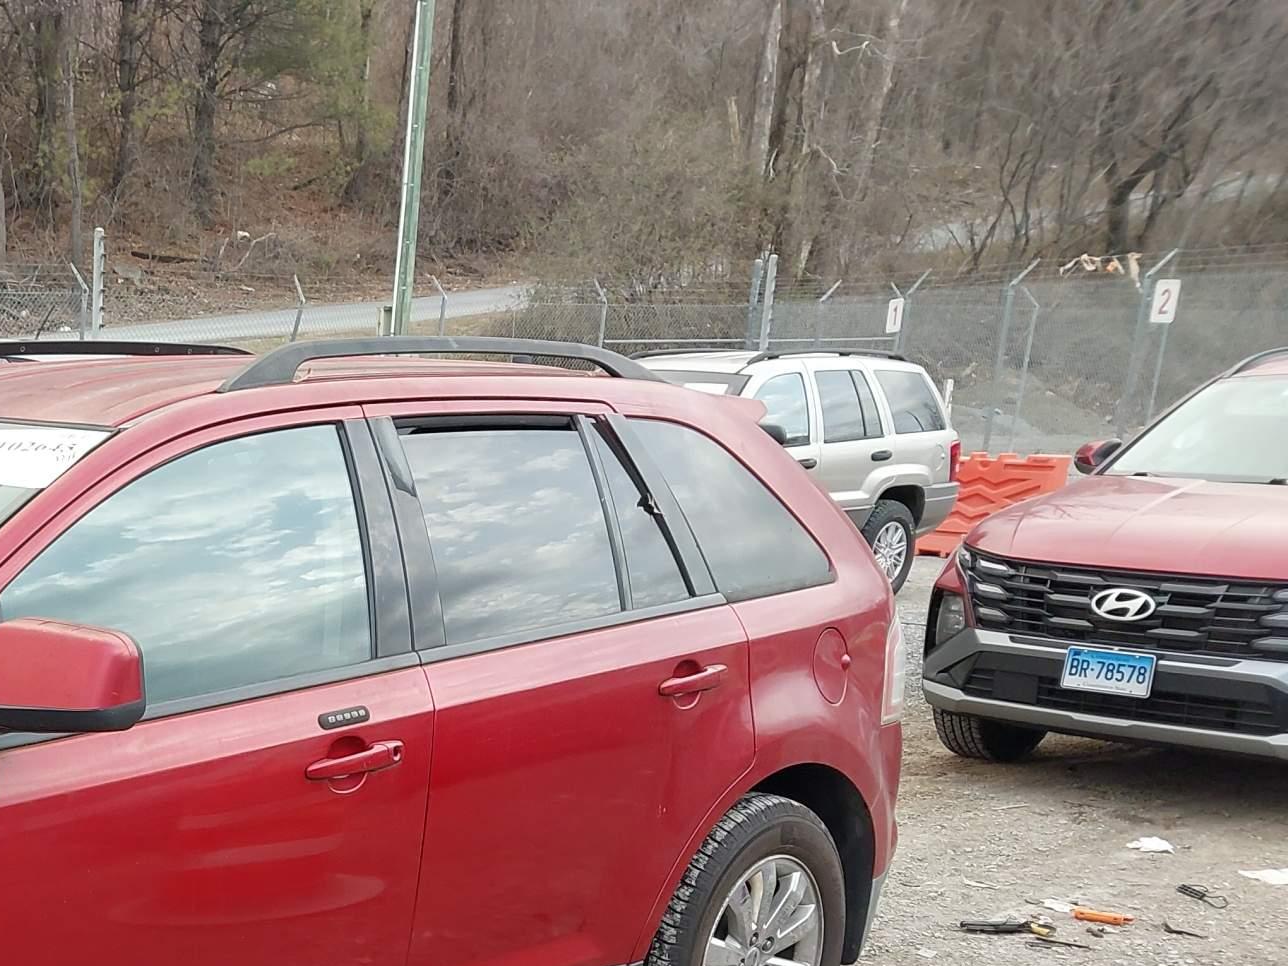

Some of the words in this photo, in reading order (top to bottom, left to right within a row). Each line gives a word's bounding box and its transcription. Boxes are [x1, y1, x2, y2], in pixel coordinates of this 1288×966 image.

[1159, 288, 1172, 315] 2
[892, 304, 899, 326] 1
[1068, 658, 1147, 684] BR-78578
